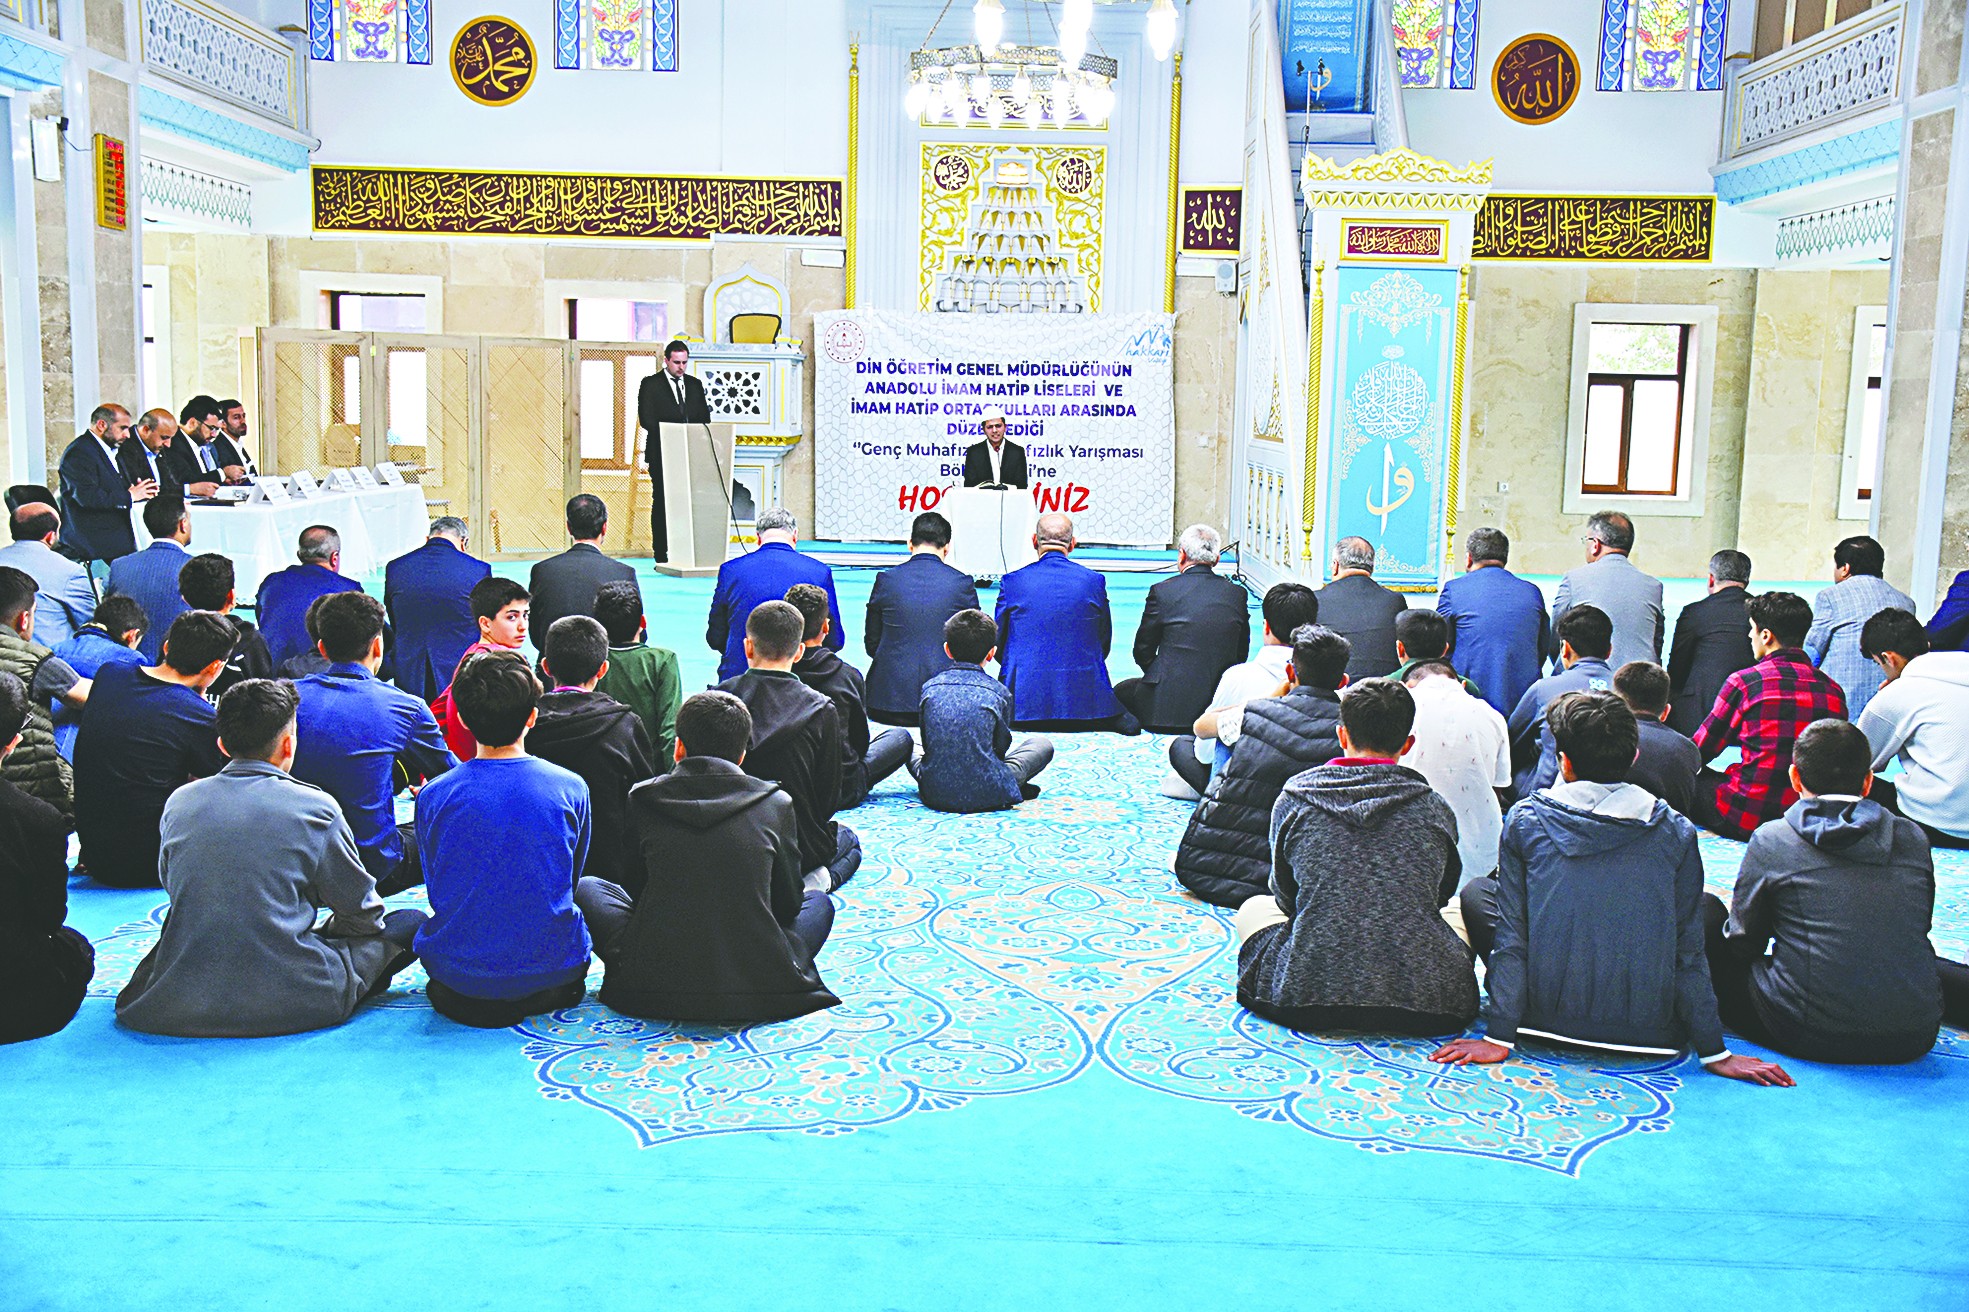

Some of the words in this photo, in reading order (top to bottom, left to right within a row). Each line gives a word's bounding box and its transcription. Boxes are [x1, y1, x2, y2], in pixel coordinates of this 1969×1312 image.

[856, 357, 882, 374] DİN
[886, 358, 952, 375] ÖĞRETİM
[956, 363, 1004, 376] GENEL
[1007, 360, 1132, 377] MÜDÜRLÜĞÜNÜN
[865, 381, 937, 395] ANADOLU
[941, 378, 982, 396] İMAM
[986, 379, 1030, 396] HATİP
[1034, 379, 1096, 397] LİSELERİ
[1104, 384, 1123, 397] VE
[851, 397, 891, 414] İMAM
[895, 398, 939, 415] HATİP
[943, 403, 1056, 416] ORTAULLARI
[1060, 404, 1137, 417] ARASINDA
[947, 419, 1044, 436] DÜZEEDİĞİ
[1068, 444, 1144, 462] Yarışması
